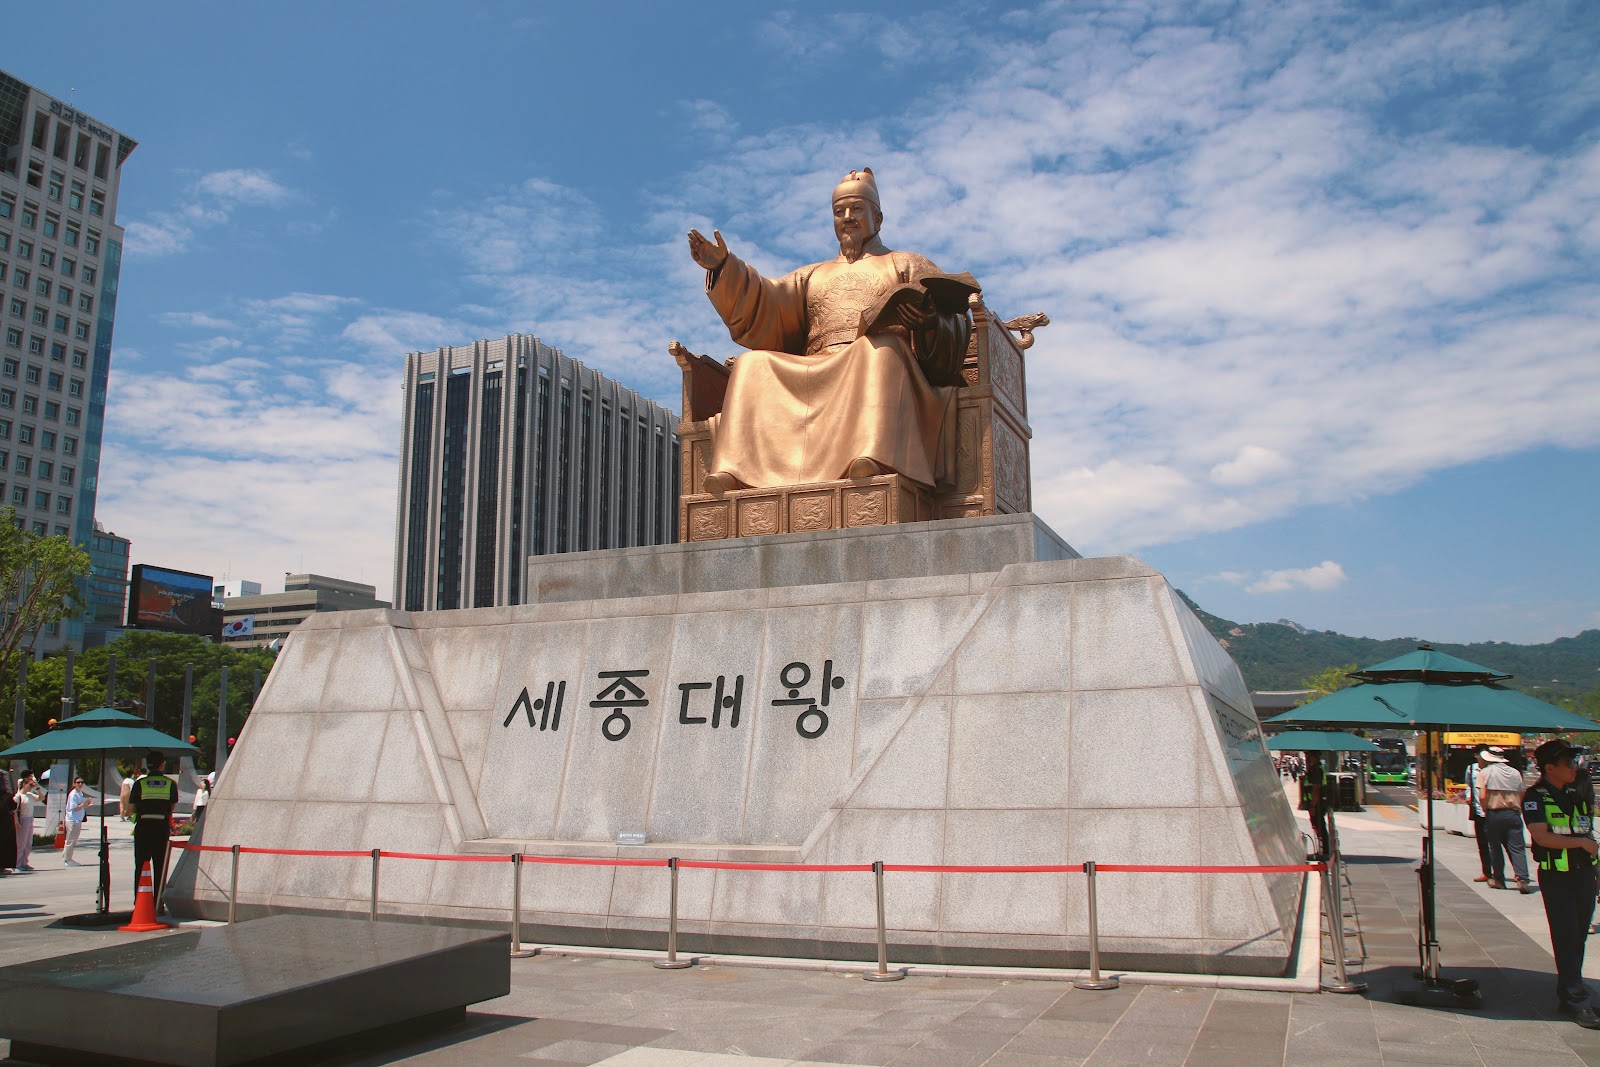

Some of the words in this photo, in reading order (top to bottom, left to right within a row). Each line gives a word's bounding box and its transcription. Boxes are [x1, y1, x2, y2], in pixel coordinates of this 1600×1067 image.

[49, 101, 87, 129] 외교부
[88, 123, 113, 142] MOFA
[503, 659, 845, 742] 세종대왕
